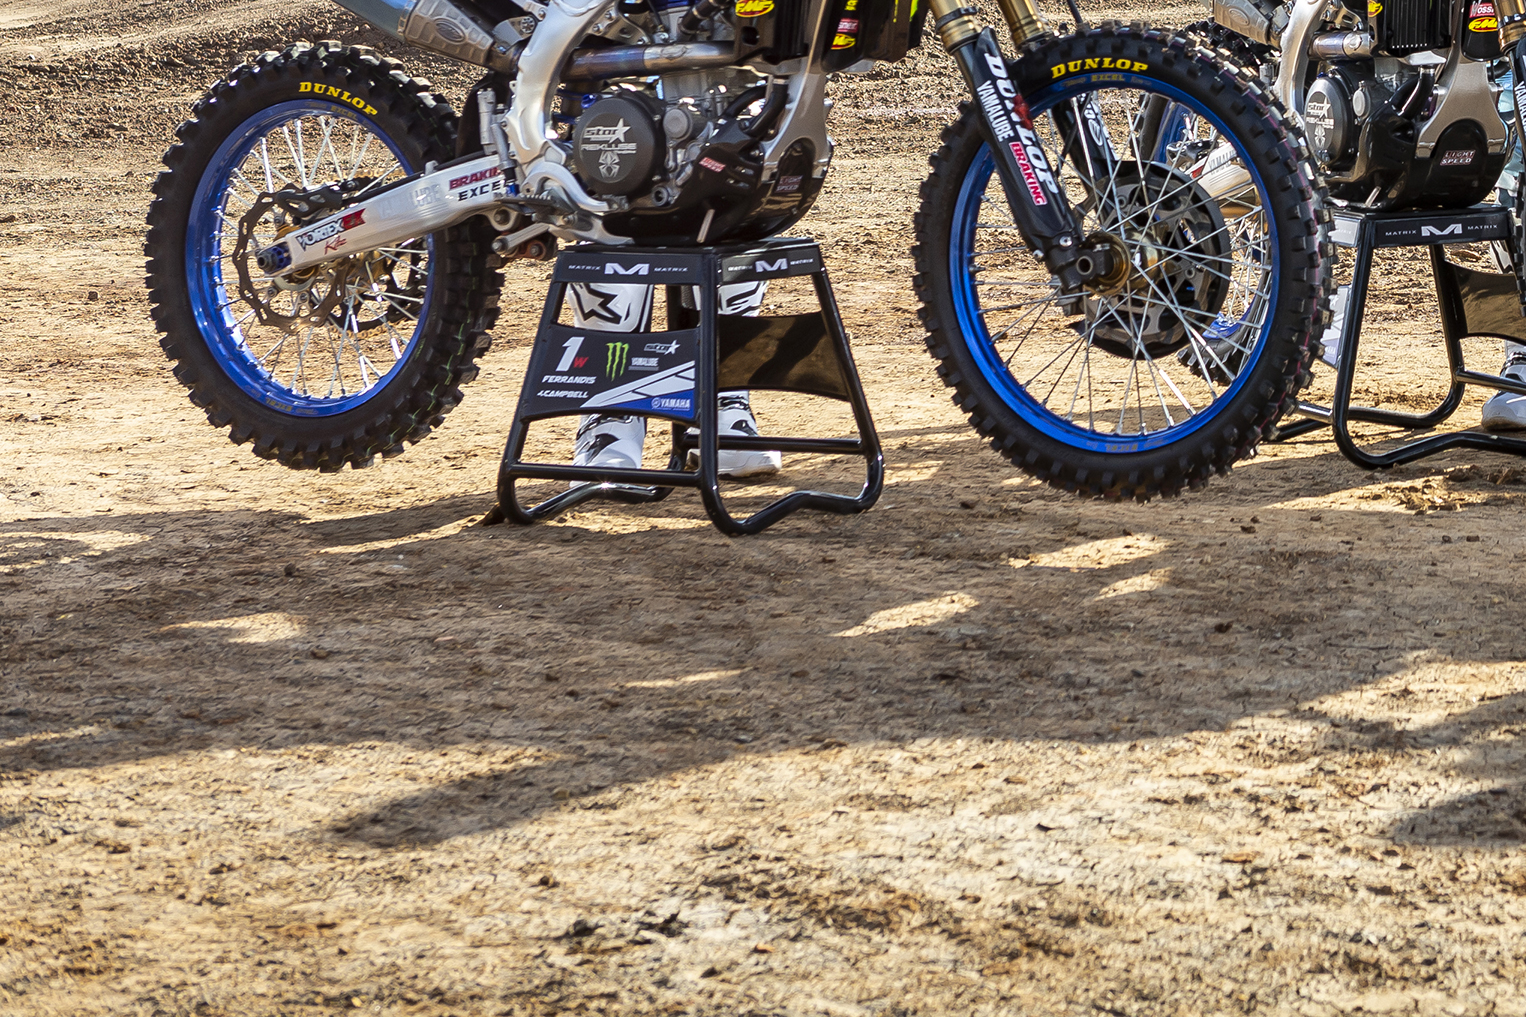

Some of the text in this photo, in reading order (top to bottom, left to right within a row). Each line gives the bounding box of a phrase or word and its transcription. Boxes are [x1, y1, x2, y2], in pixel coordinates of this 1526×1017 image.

[735, 0, 775, 13] FMF
[1050, 56, 1149, 80] DUNLOP
[298, 81, 379, 116] DUNLOP
[976, 79, 1015, 142] YAMALUBE
[1440, 157, 1473, 166] SPEED
[1444, 149, 1476, 158] LIGHT
[1008, 140, 1048, 206] BRAKING
[296, 218, 346, 252] VORTEX
[1467, 224, 1498, 232] MATRIX
[555, 336, 586, 372] 1
[541, 375, 598, 385] FERRANDIS
[660, 398, 692, 410] YAMAHA
